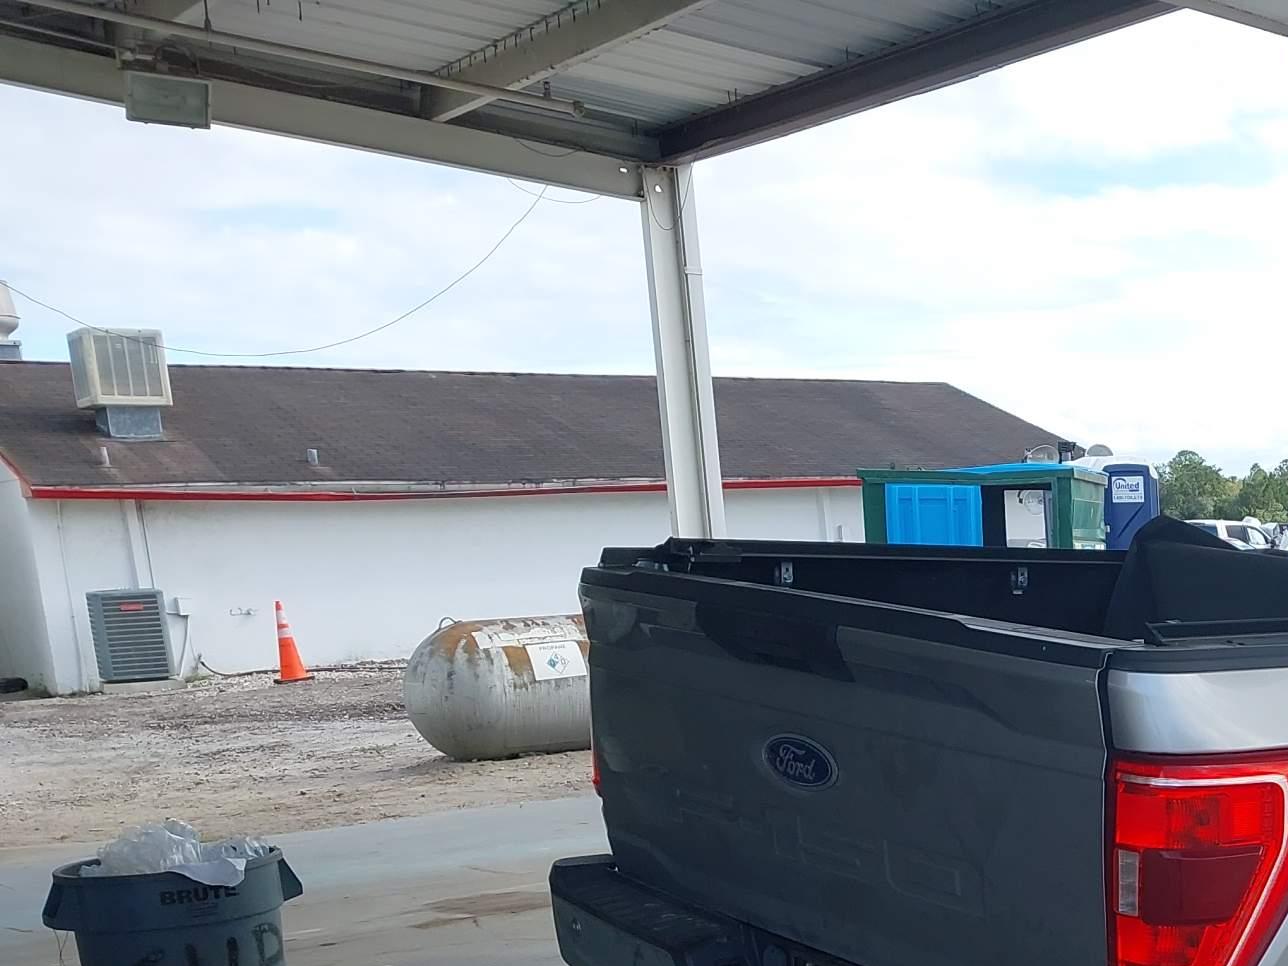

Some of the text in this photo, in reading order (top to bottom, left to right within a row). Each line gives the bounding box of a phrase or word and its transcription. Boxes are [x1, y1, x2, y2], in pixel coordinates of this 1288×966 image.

[1115, 481, 1140, 490] United
[538, 643, 566, 651] PROPANE
[776, 743, 816, 780] Ford
[159, 886, 240, 906] BRUTE
